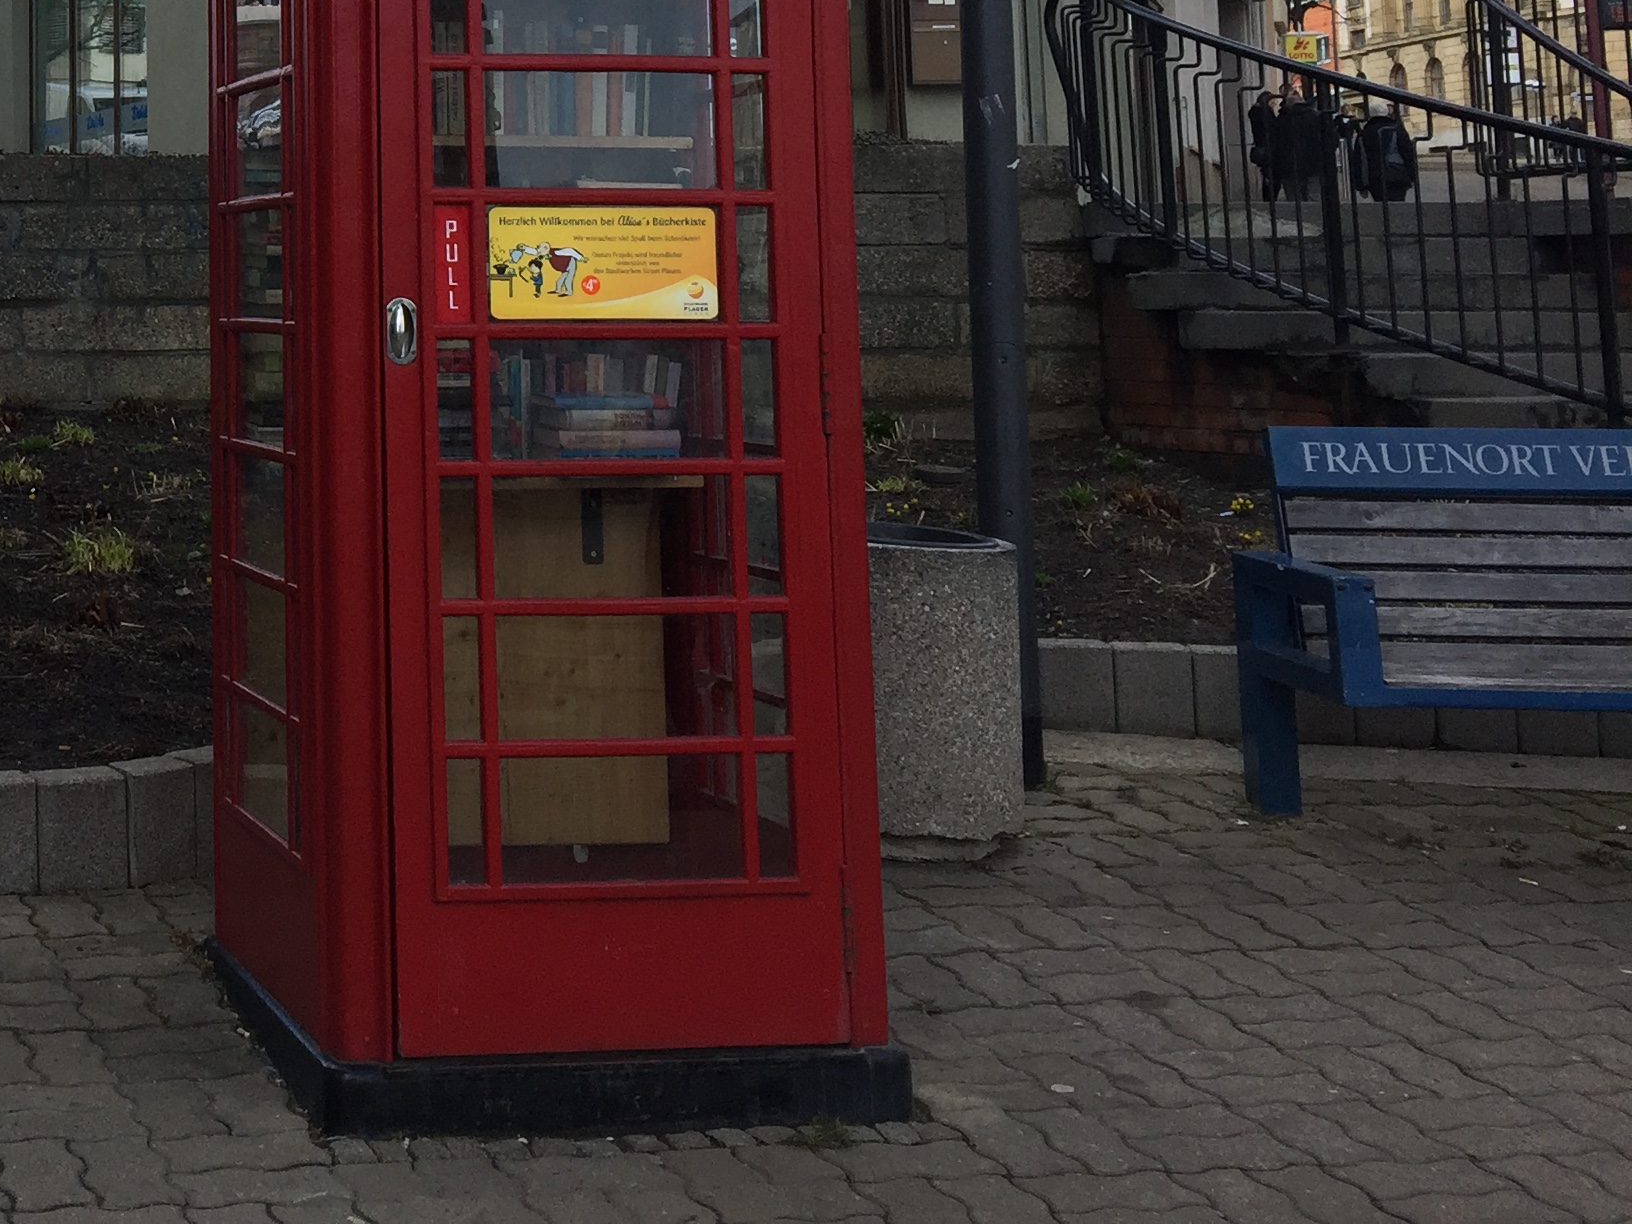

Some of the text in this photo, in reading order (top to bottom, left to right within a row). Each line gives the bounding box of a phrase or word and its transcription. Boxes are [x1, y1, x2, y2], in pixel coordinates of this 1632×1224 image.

[499, 216, 536, 226] Herzlich
[539, 216, 597, 226] Willkommen
[600, 216, 614, 226] bei
[446, 220, 459, 309] PULL
[1300, 442, 1561, 477] FRAUENORT
